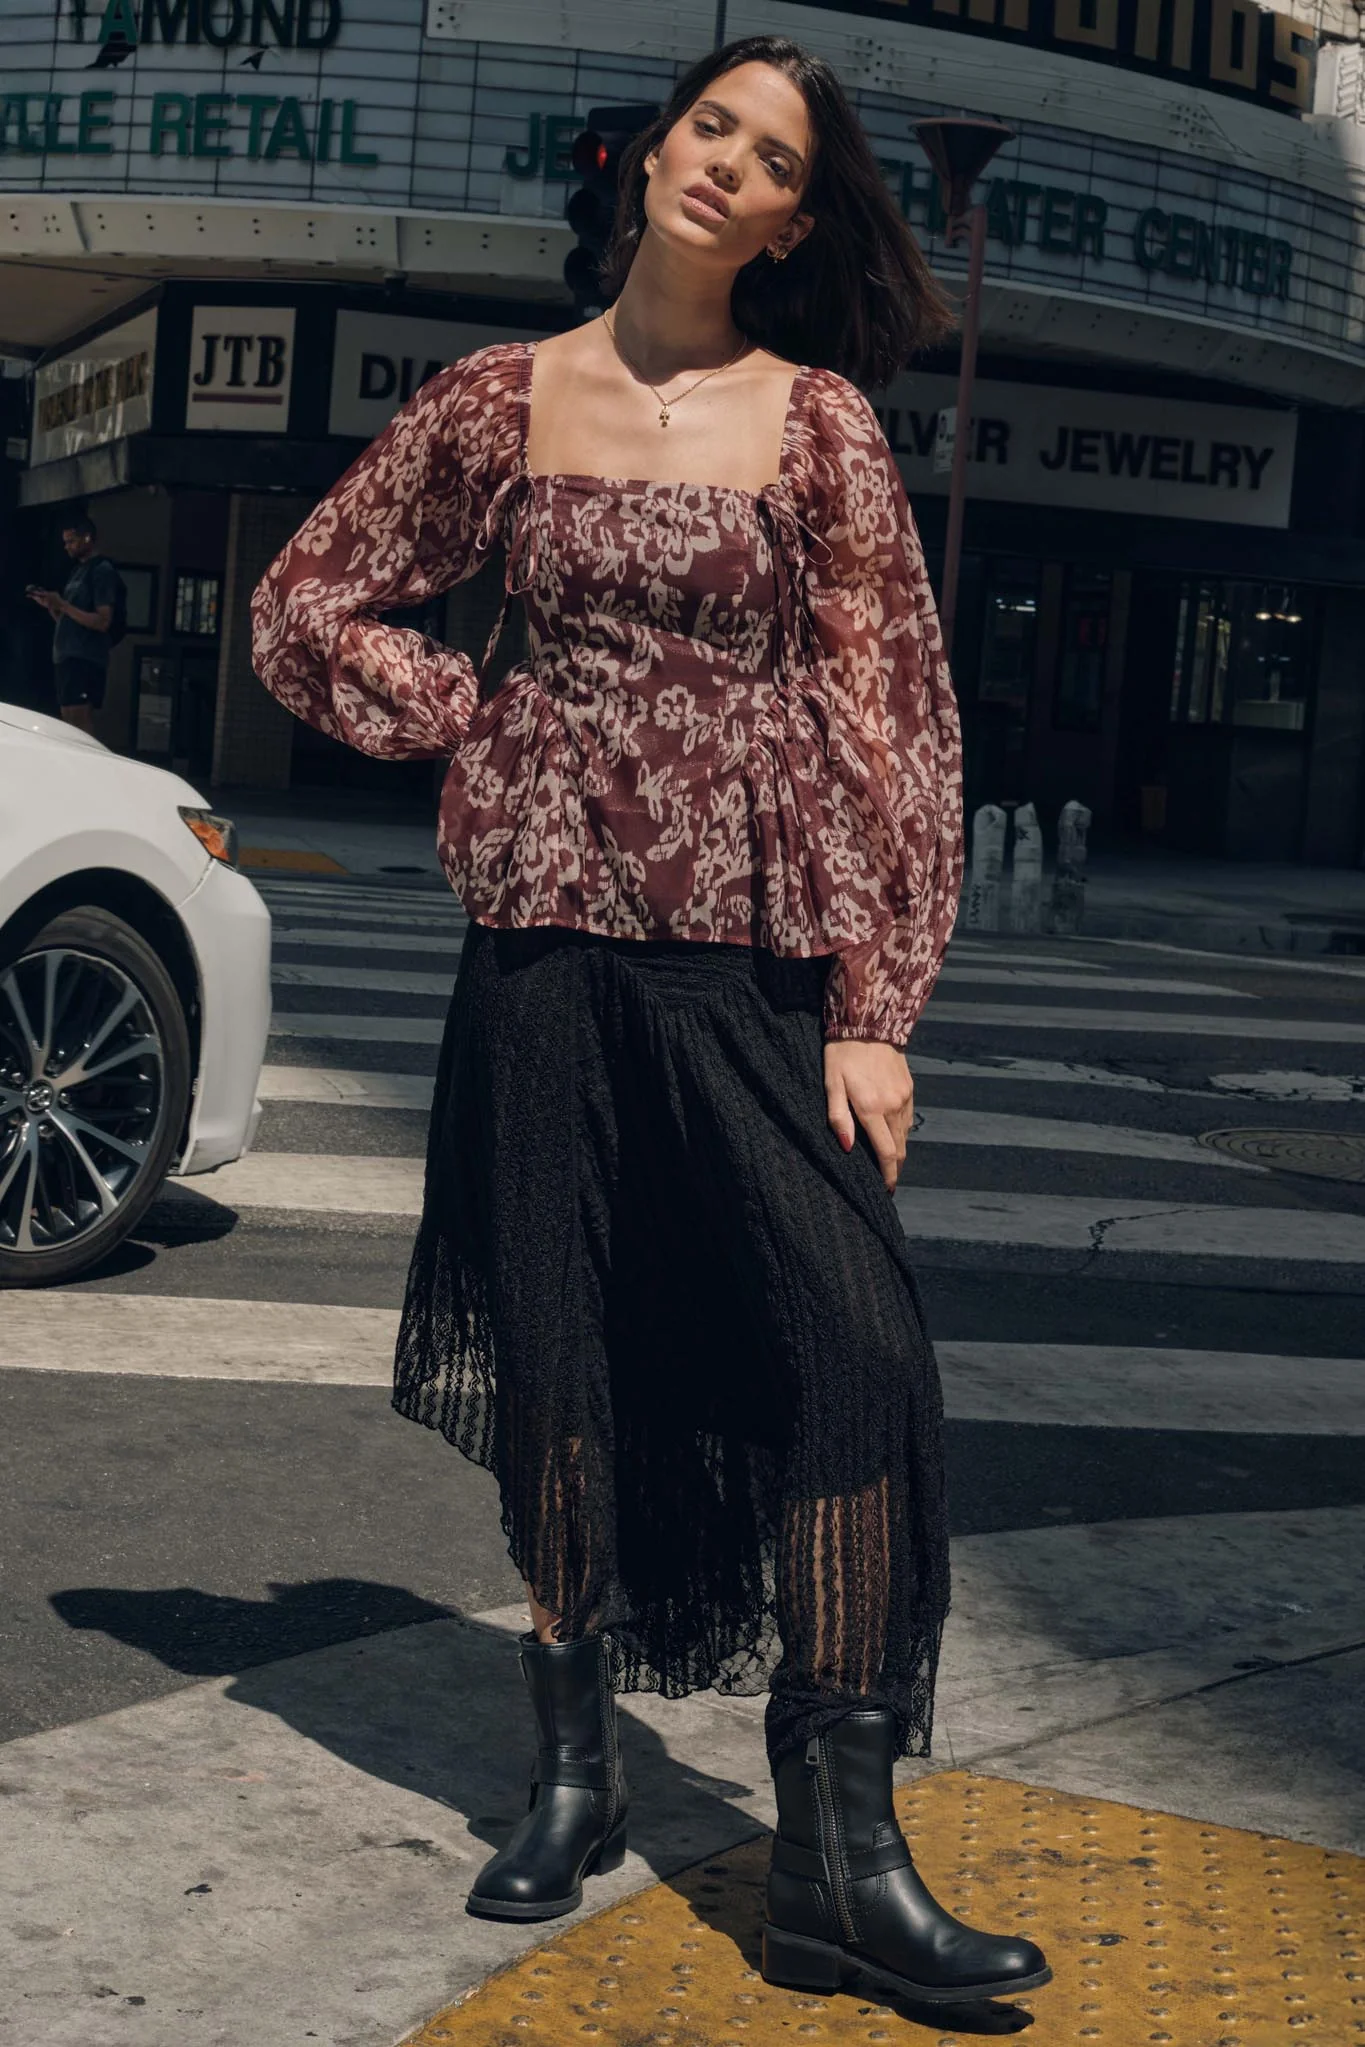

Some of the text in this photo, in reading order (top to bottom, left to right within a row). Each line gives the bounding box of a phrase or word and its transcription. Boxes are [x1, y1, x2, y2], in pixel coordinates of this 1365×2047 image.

[150, 93, 378, 164] RETAIL
[877, 157, 1292, 301] HATER CENTER
[194, 335, 286, 388] JTB
[872, 407, 1010, 464] LVR
[1039, 426, 1274, 490] JEWELRY
